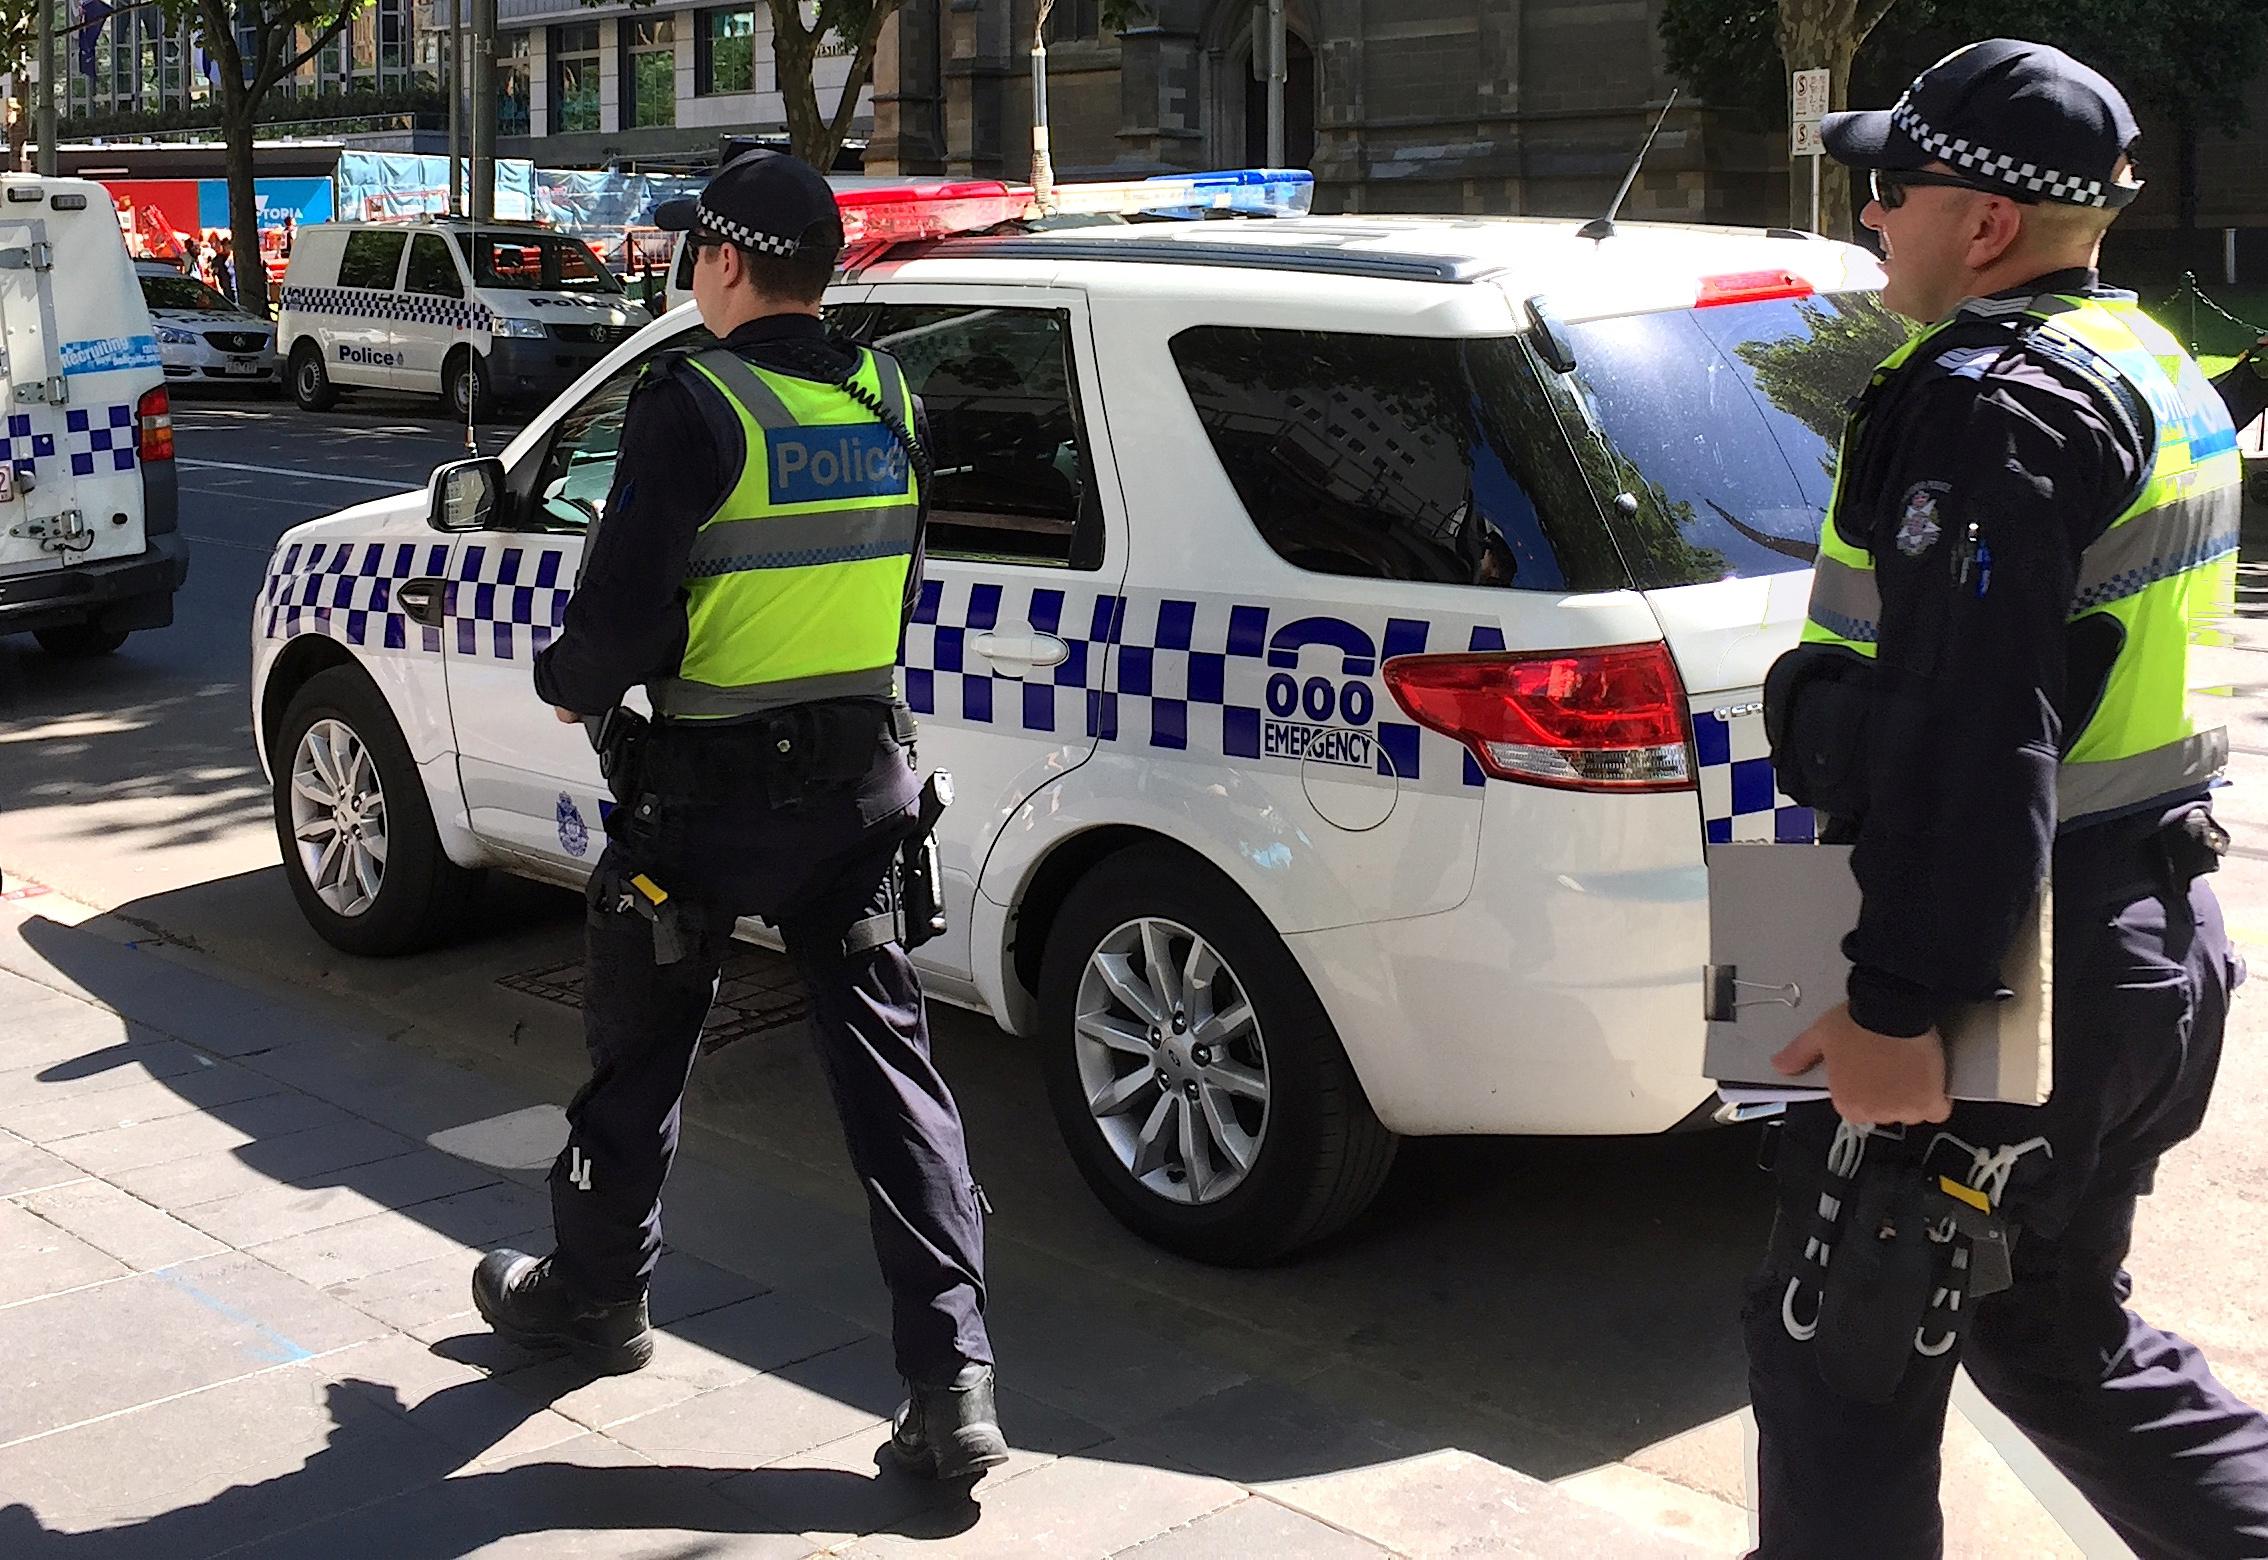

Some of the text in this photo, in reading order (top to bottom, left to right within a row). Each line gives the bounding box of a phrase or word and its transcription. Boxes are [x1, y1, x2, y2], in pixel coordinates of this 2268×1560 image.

[257, 207, 304, 220] TORIA
[61, 339, 129, 369] Recruiting
[339, 344, 394, 366] Police
[775, 436, 906, 489] Police
[1265, 672, 1374, 726] 000
[1264, 722, 1372, 764] EMERGENCY
